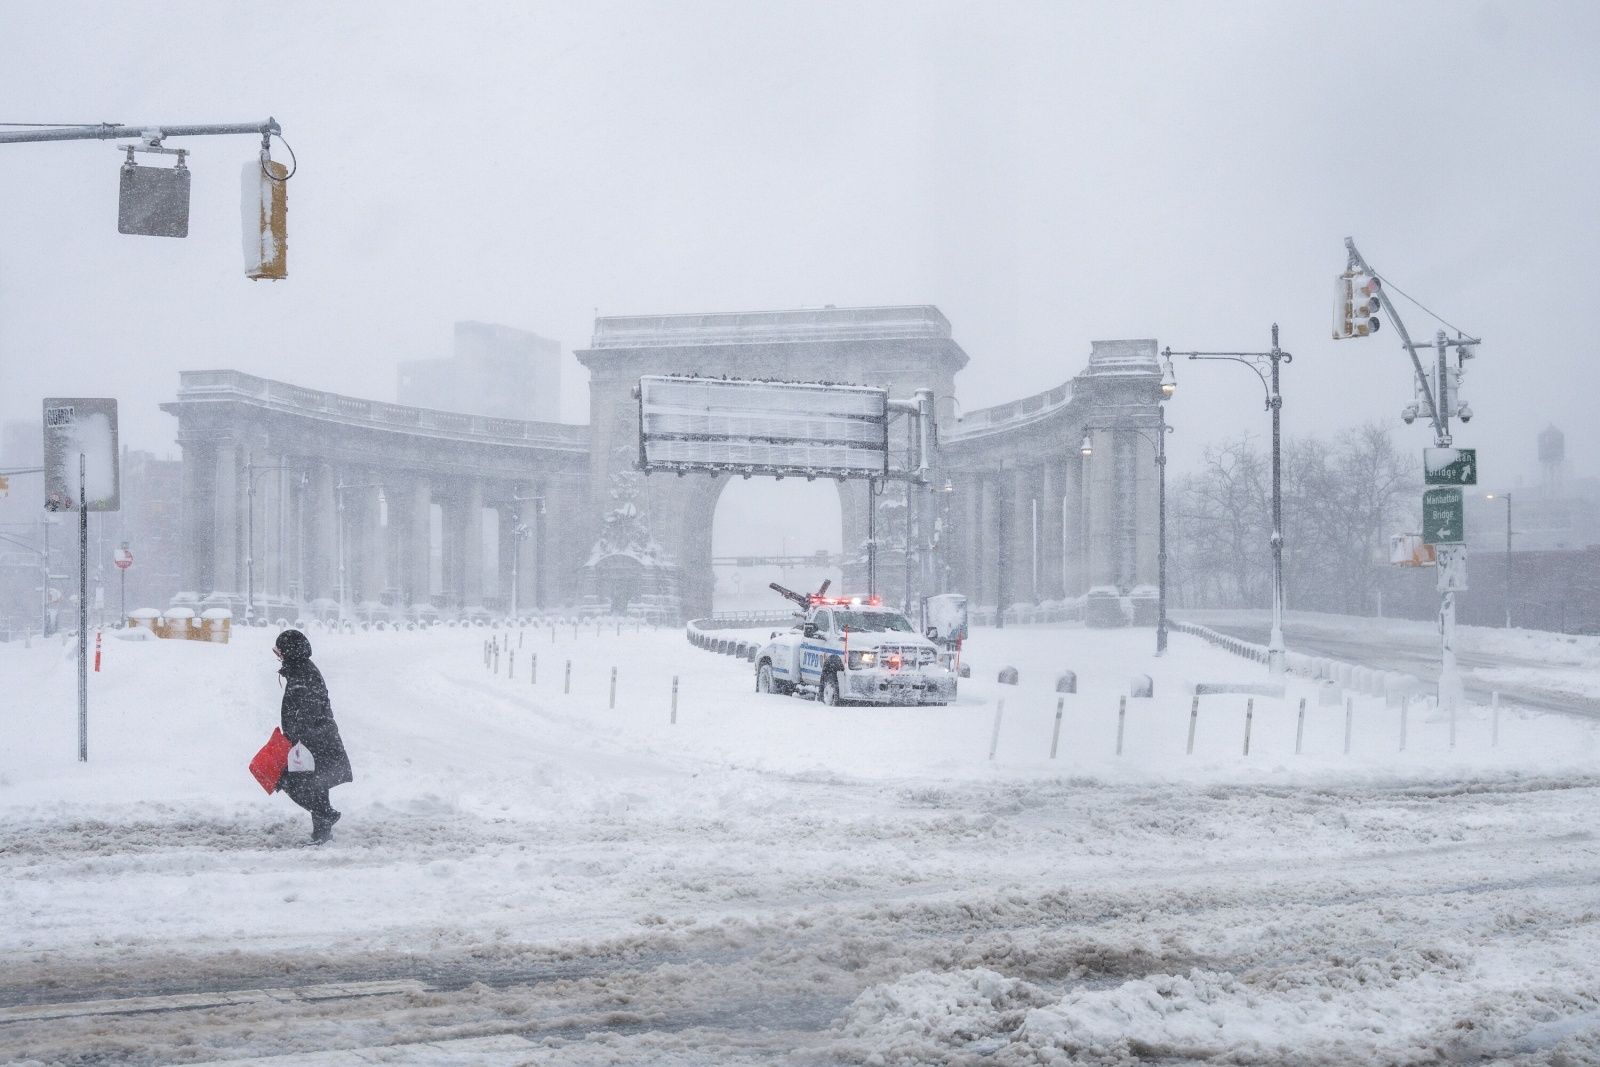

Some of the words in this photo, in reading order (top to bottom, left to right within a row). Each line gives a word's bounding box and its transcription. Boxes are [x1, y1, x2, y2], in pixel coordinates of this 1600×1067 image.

[1426, 494, 1459, 505] Manhattan
[1432, 510, 1455, 521] Bridge
[803, 650, 819, 668] NYPD
